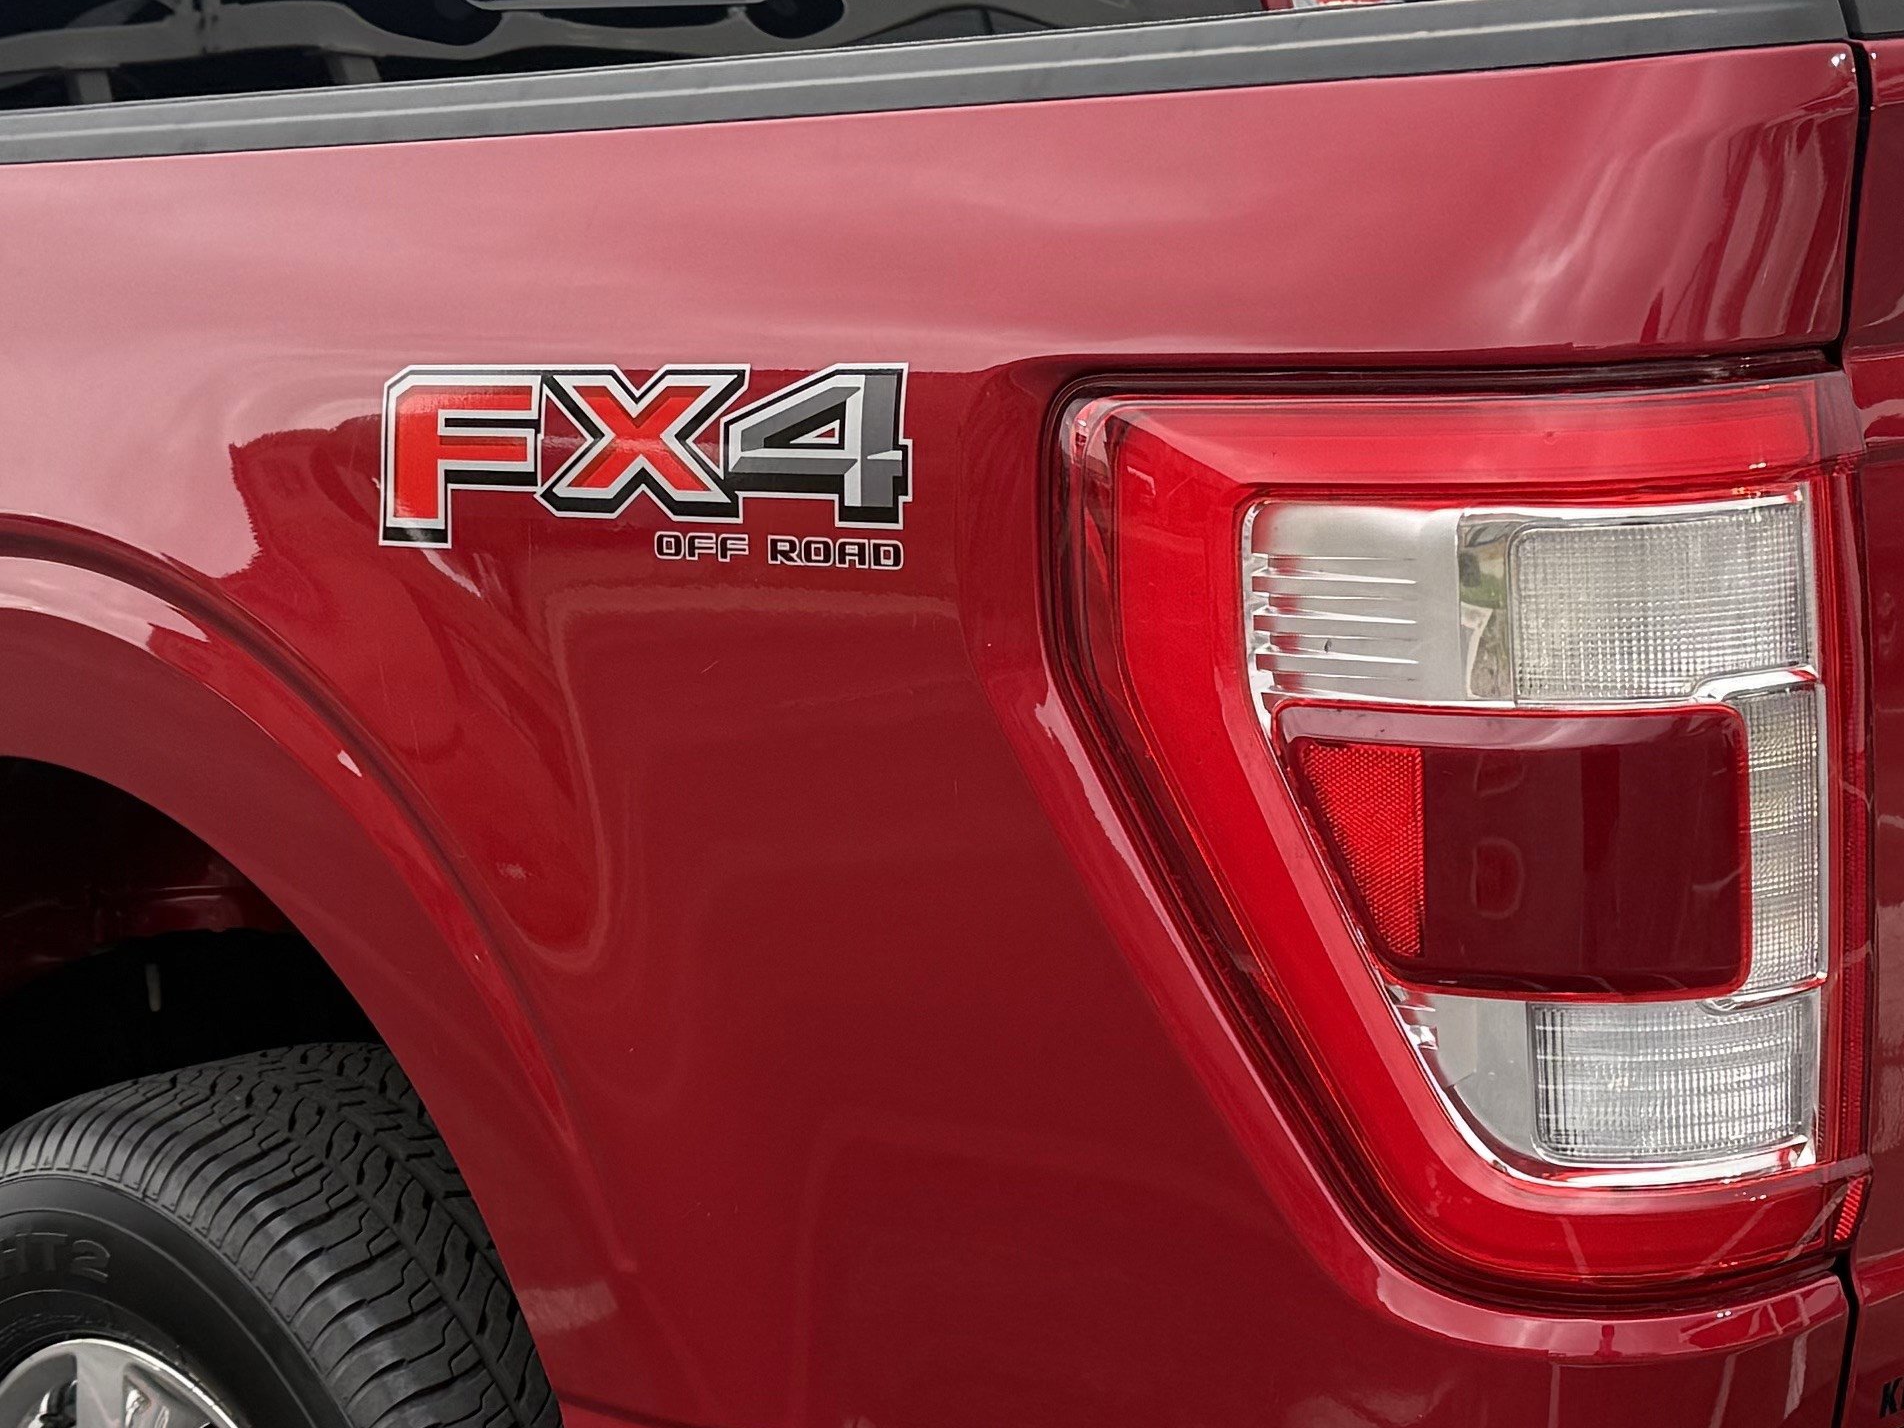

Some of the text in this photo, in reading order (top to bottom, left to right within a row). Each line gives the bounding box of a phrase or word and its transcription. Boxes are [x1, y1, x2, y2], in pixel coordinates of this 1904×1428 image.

[378, 362, 913, 549] FX4
[653, 530, 905, 571] OFF ROAD
